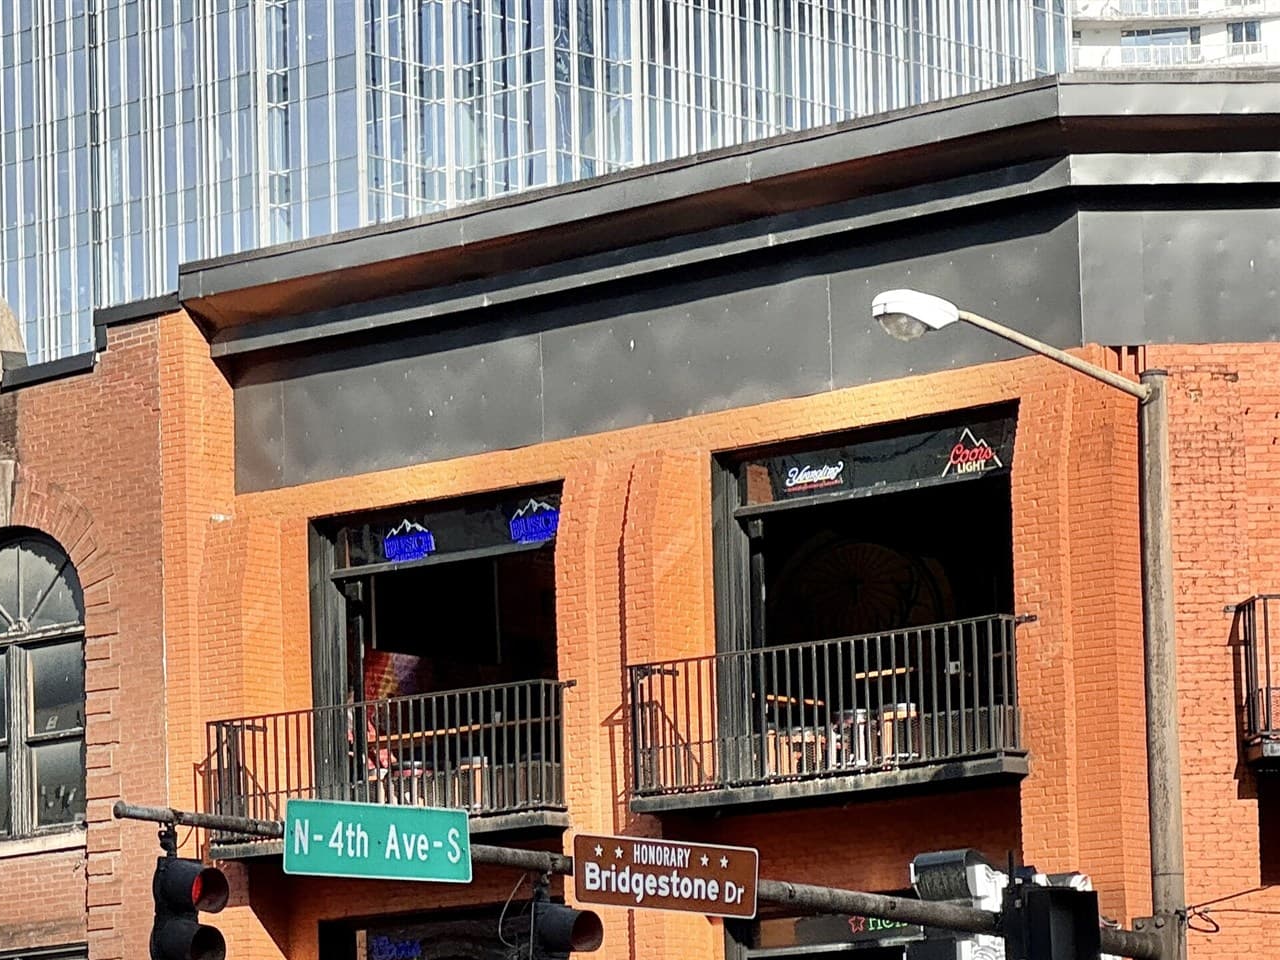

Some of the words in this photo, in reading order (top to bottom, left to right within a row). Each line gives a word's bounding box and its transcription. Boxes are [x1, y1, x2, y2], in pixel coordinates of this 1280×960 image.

[950, 443, 993, 465] Coors
[957, 459, 986, 474] LIGHT
[633, 843, 691, 868] HONORARY
[584, 861, 720, 904] Bridgestone
[724, 881, 745, 905] Dr
